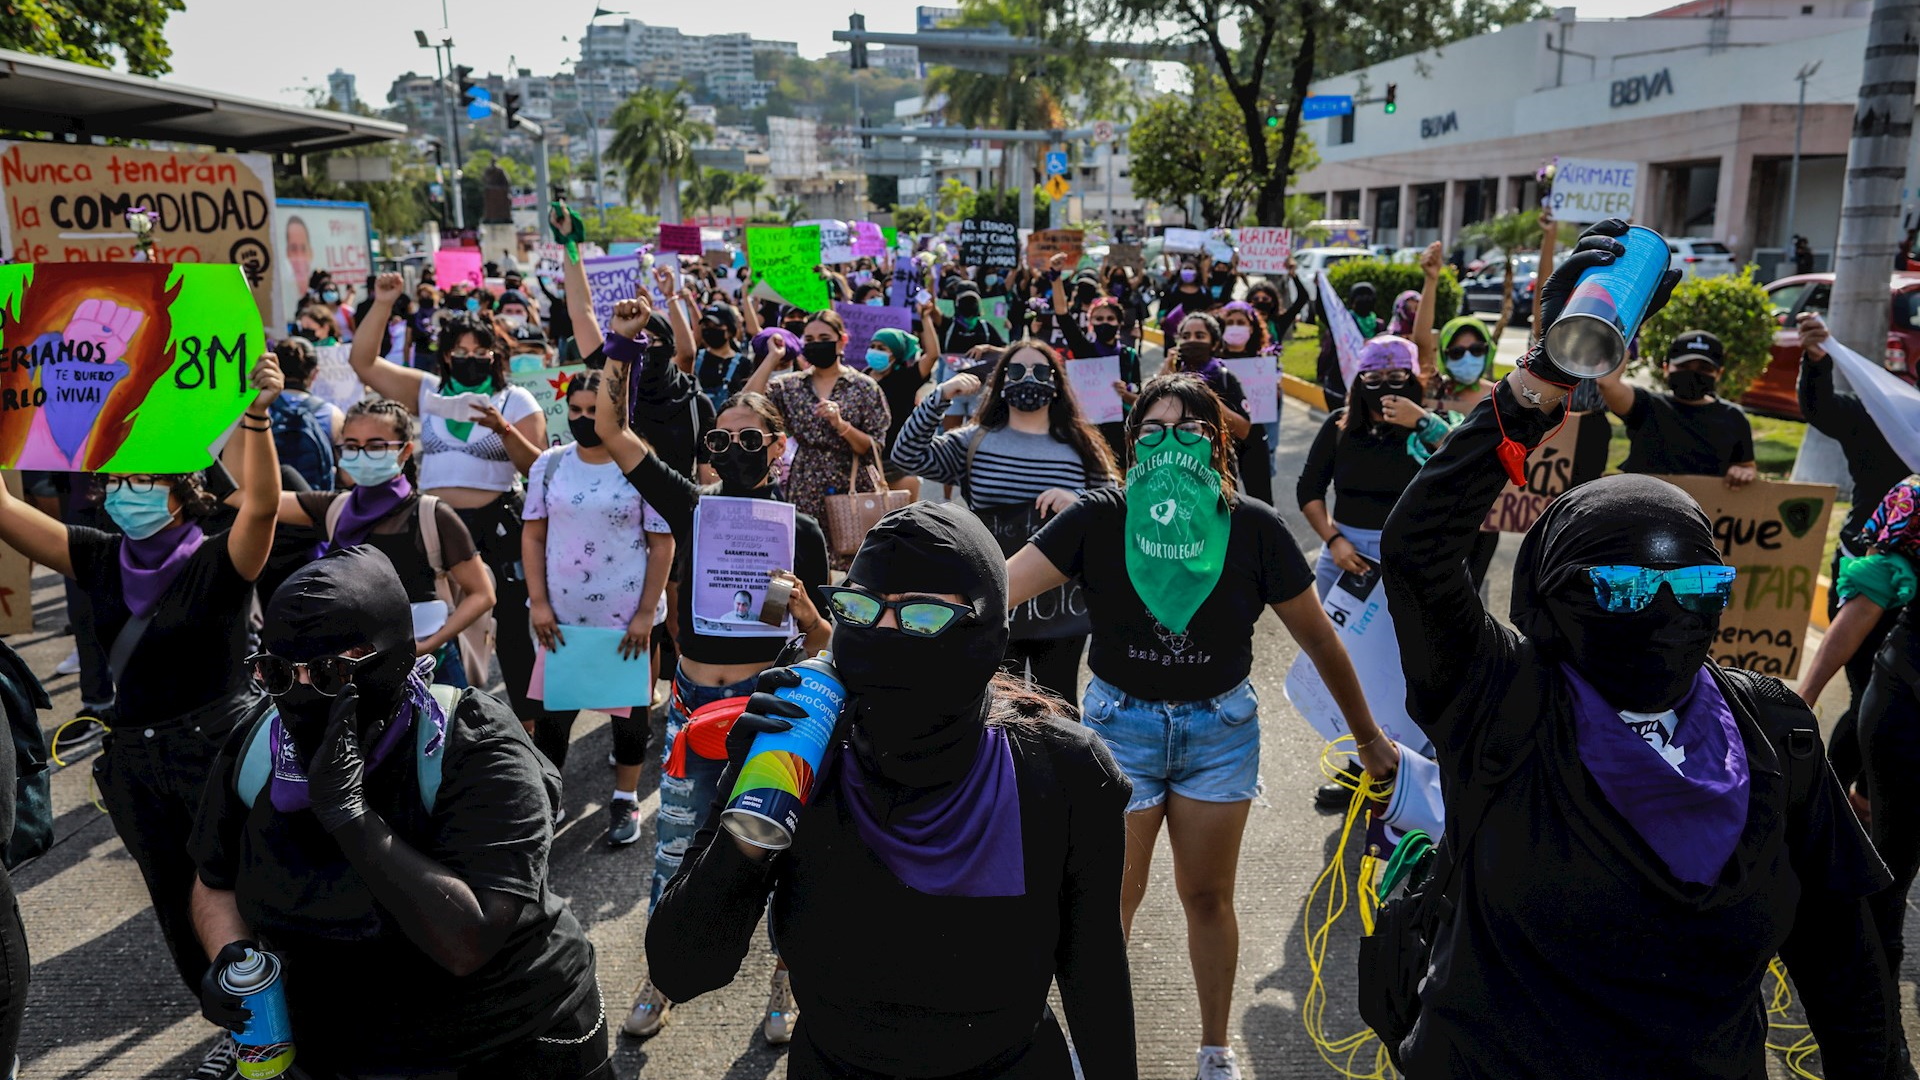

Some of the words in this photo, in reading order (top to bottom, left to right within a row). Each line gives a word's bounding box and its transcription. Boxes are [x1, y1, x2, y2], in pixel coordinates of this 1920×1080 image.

[1609, 67, 1674, 108] BBVA
[1421, 110, 1458, 139] BBVA
[1, 146, 92, 187] Nunca
[107, 155, 237, 185] tendrán
[13, 196, 41, 230] la
[1565, 191, 1631, 213] MUJER
[65, 242, 201, 263] nuetro
[56, 370, 69, 381] TE
[74, 371, 114, 382] QUIERO
[175, 333, 247, 396] 8M
[1147, 451, 1173, 471] LEGAL
[1175, 452, 1198, 472] PARA
[1728, 565, 1813, 612] TAR
[1348, 601, 1380, 636] Tierra
[801, 677, 843, 706] Comex
